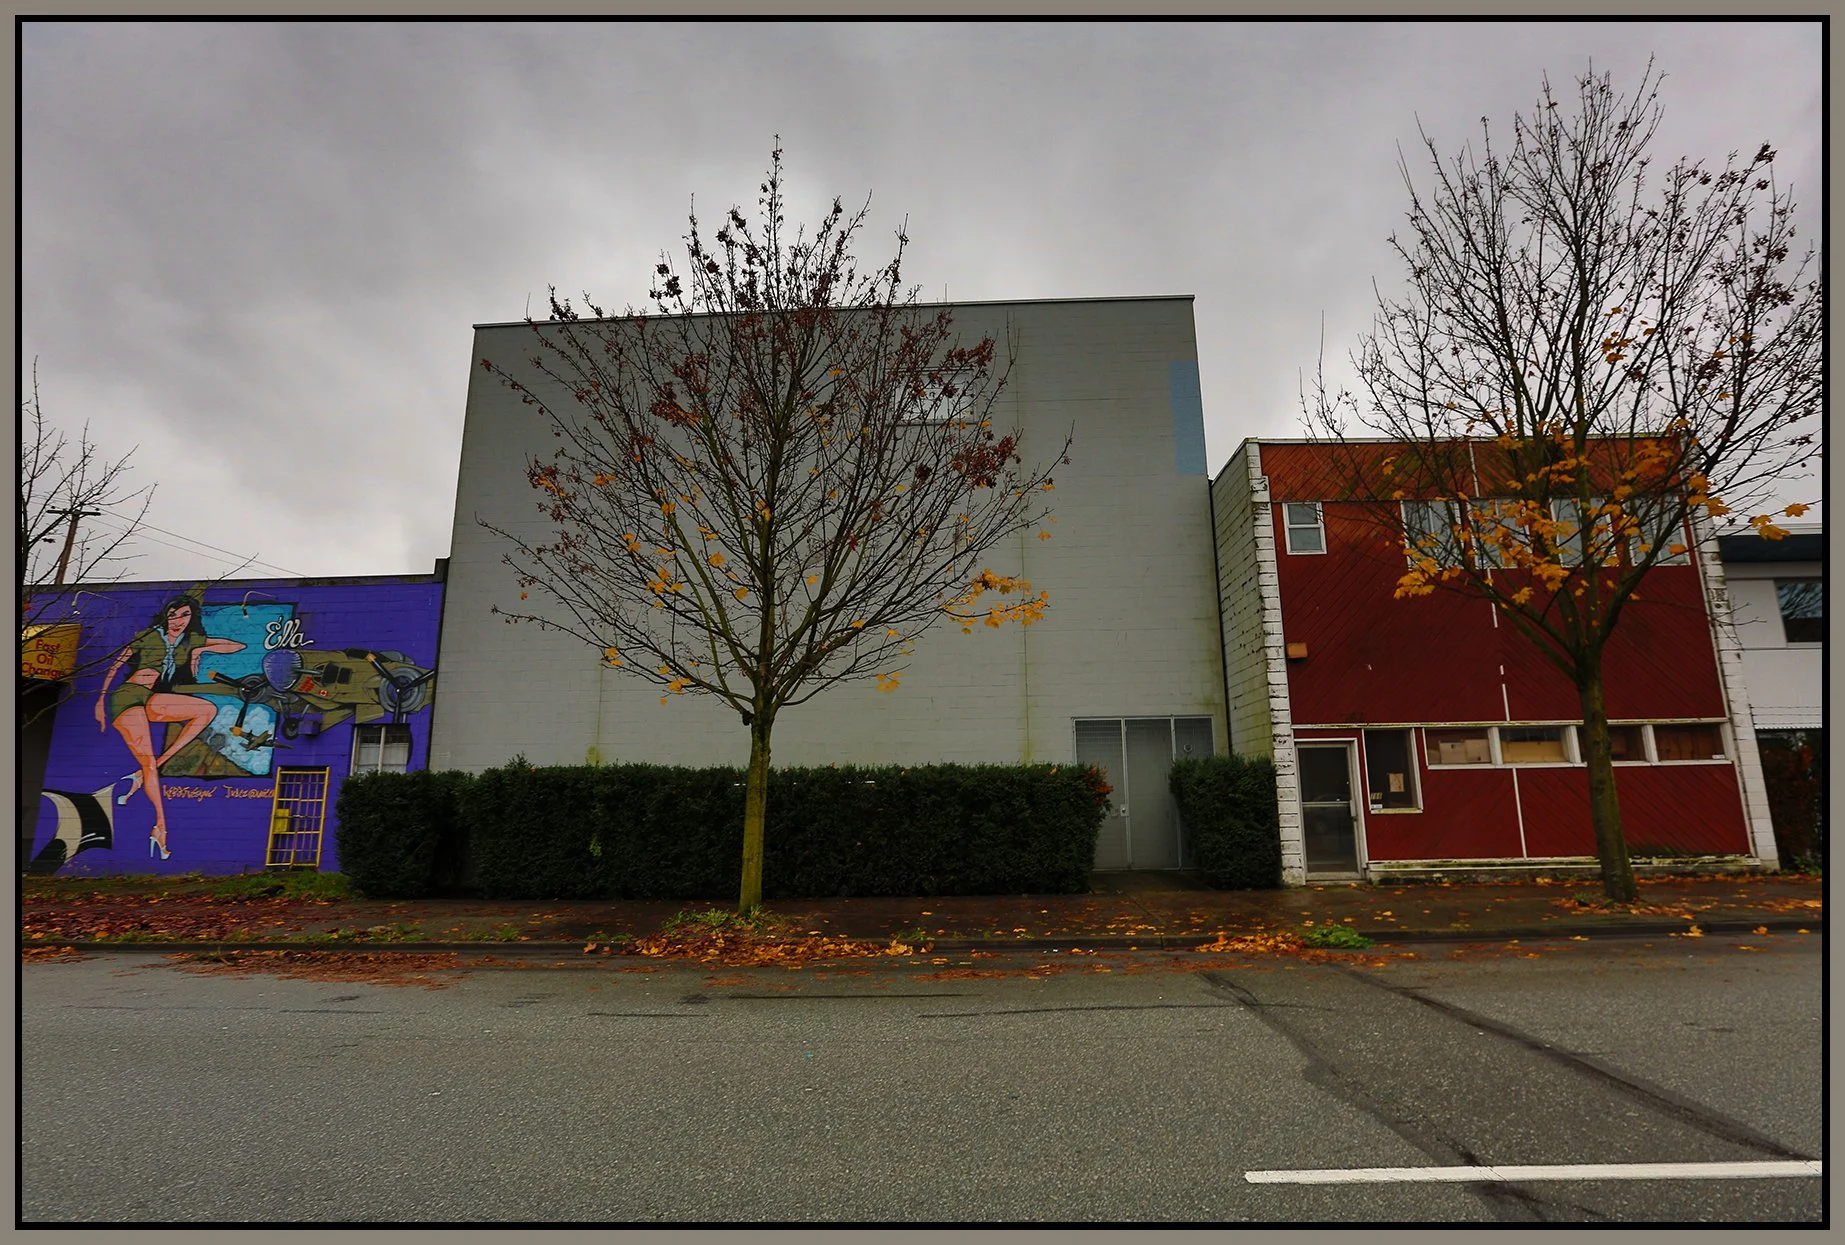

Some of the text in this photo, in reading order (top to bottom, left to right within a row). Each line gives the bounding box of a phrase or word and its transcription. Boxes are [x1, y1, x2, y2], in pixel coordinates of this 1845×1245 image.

[36, 639, 60, 651] Fast
[37, 654, 53, 665] Oil
[22, 662, 65, 680] Change
